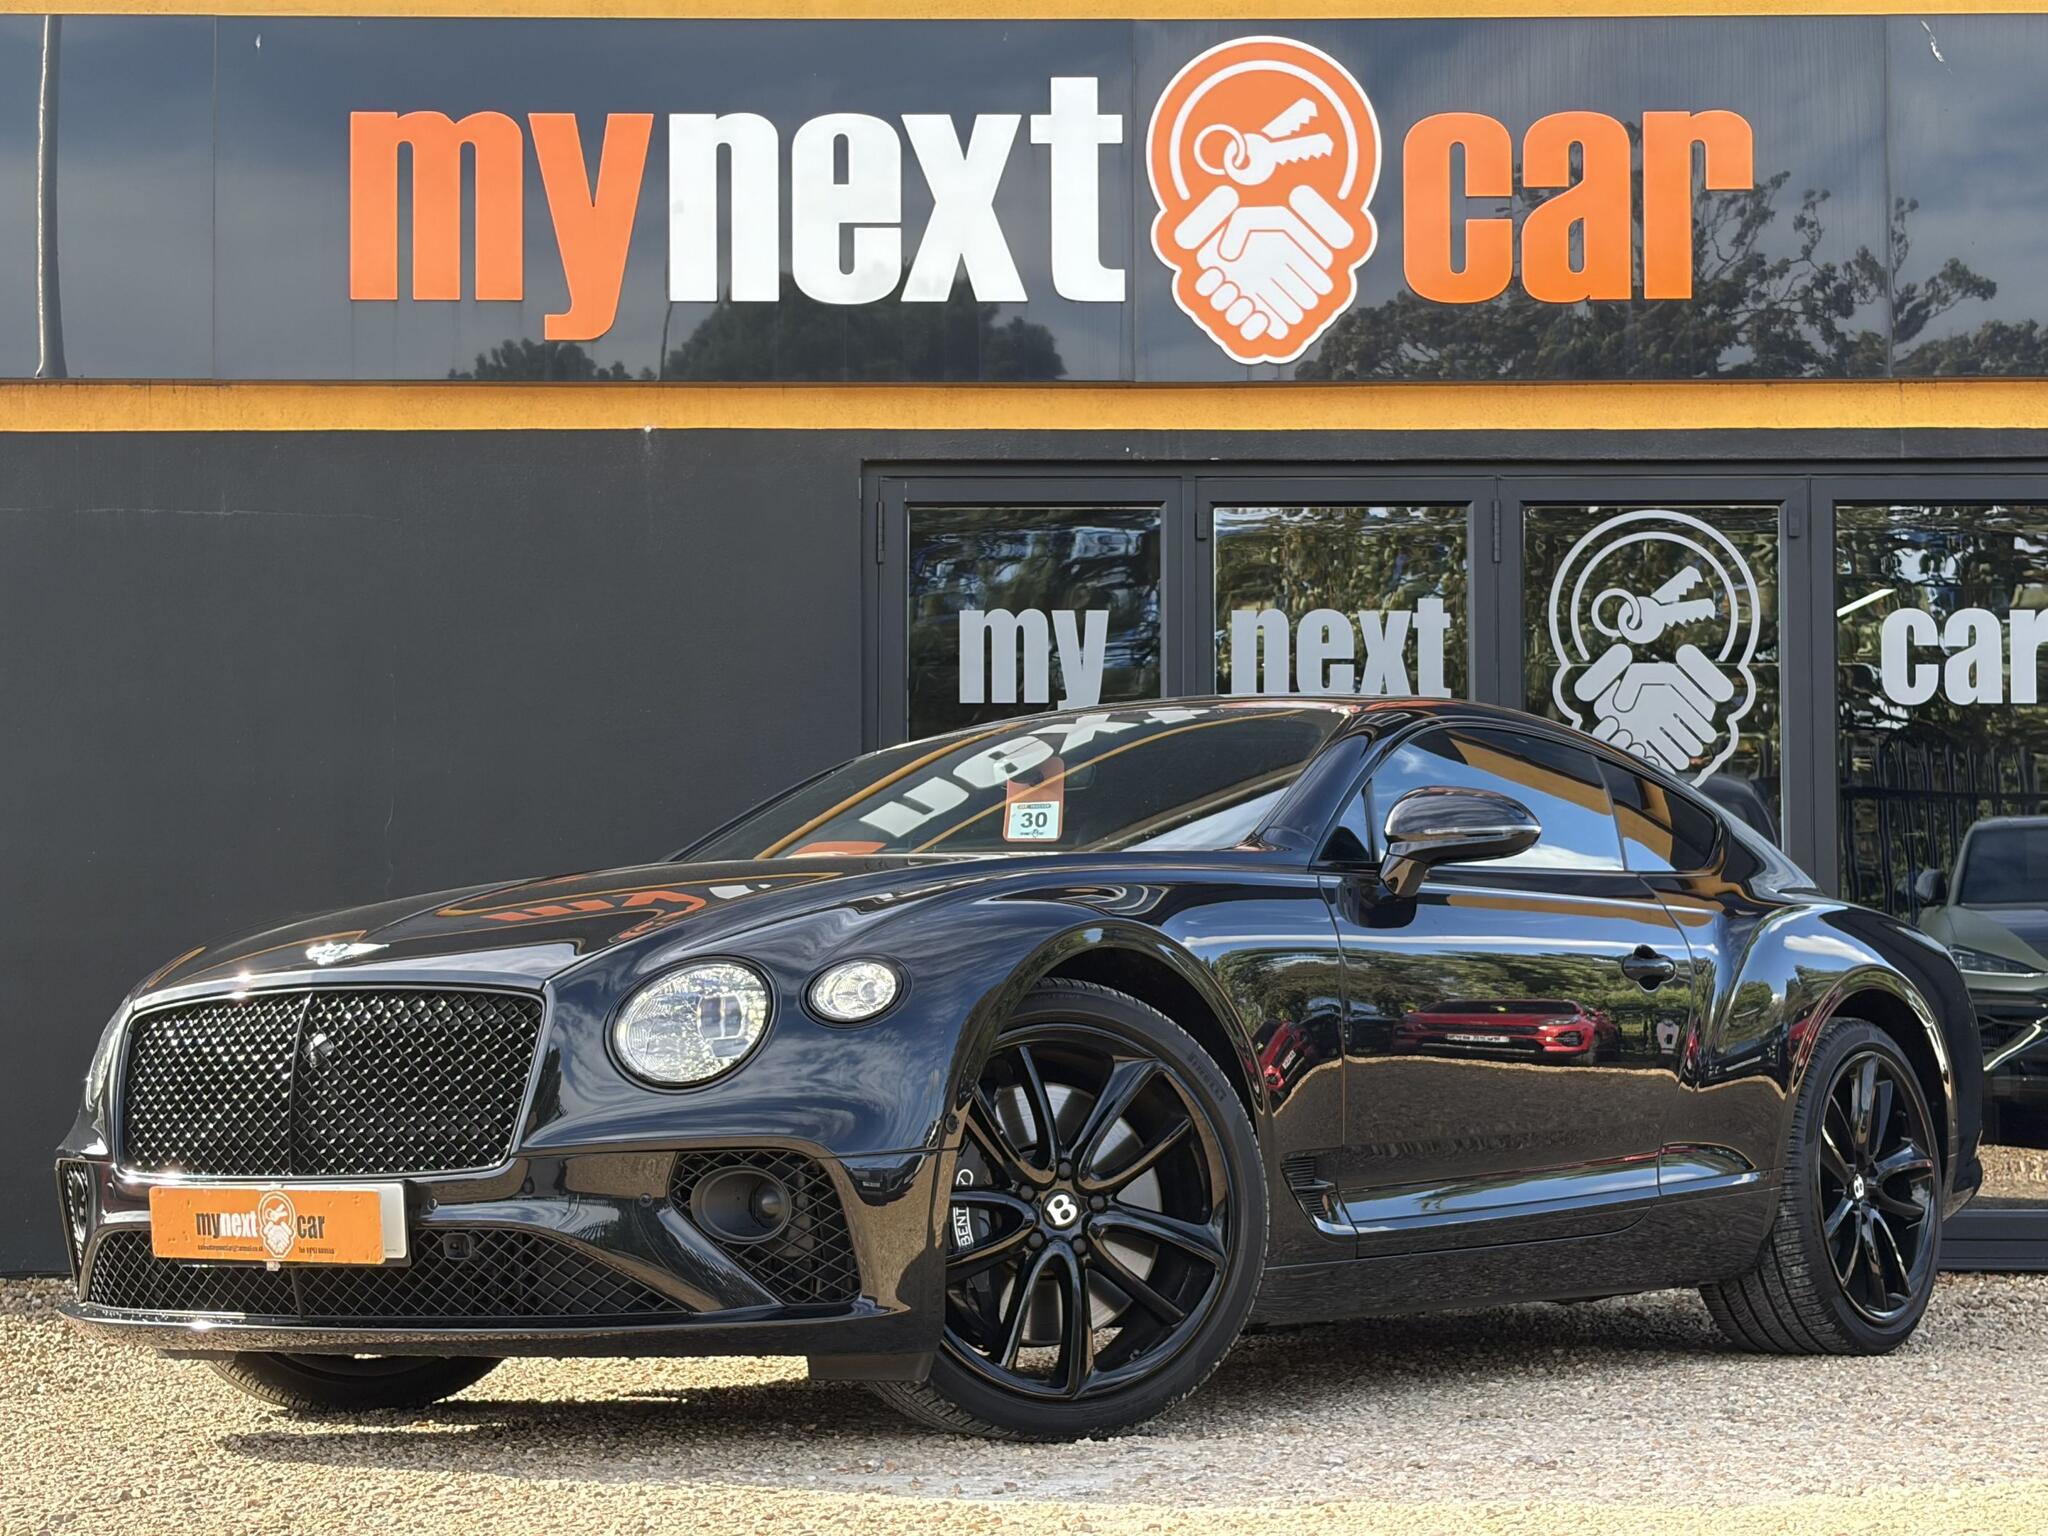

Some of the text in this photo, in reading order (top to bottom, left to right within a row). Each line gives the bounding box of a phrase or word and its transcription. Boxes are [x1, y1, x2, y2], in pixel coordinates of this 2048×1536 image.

[1403, 110, 1754, 304] car
[959, 598, 2048, 709] my next car
[1020, 811, 1048, 829] 30
[296, 1213, 326, 1240] car
